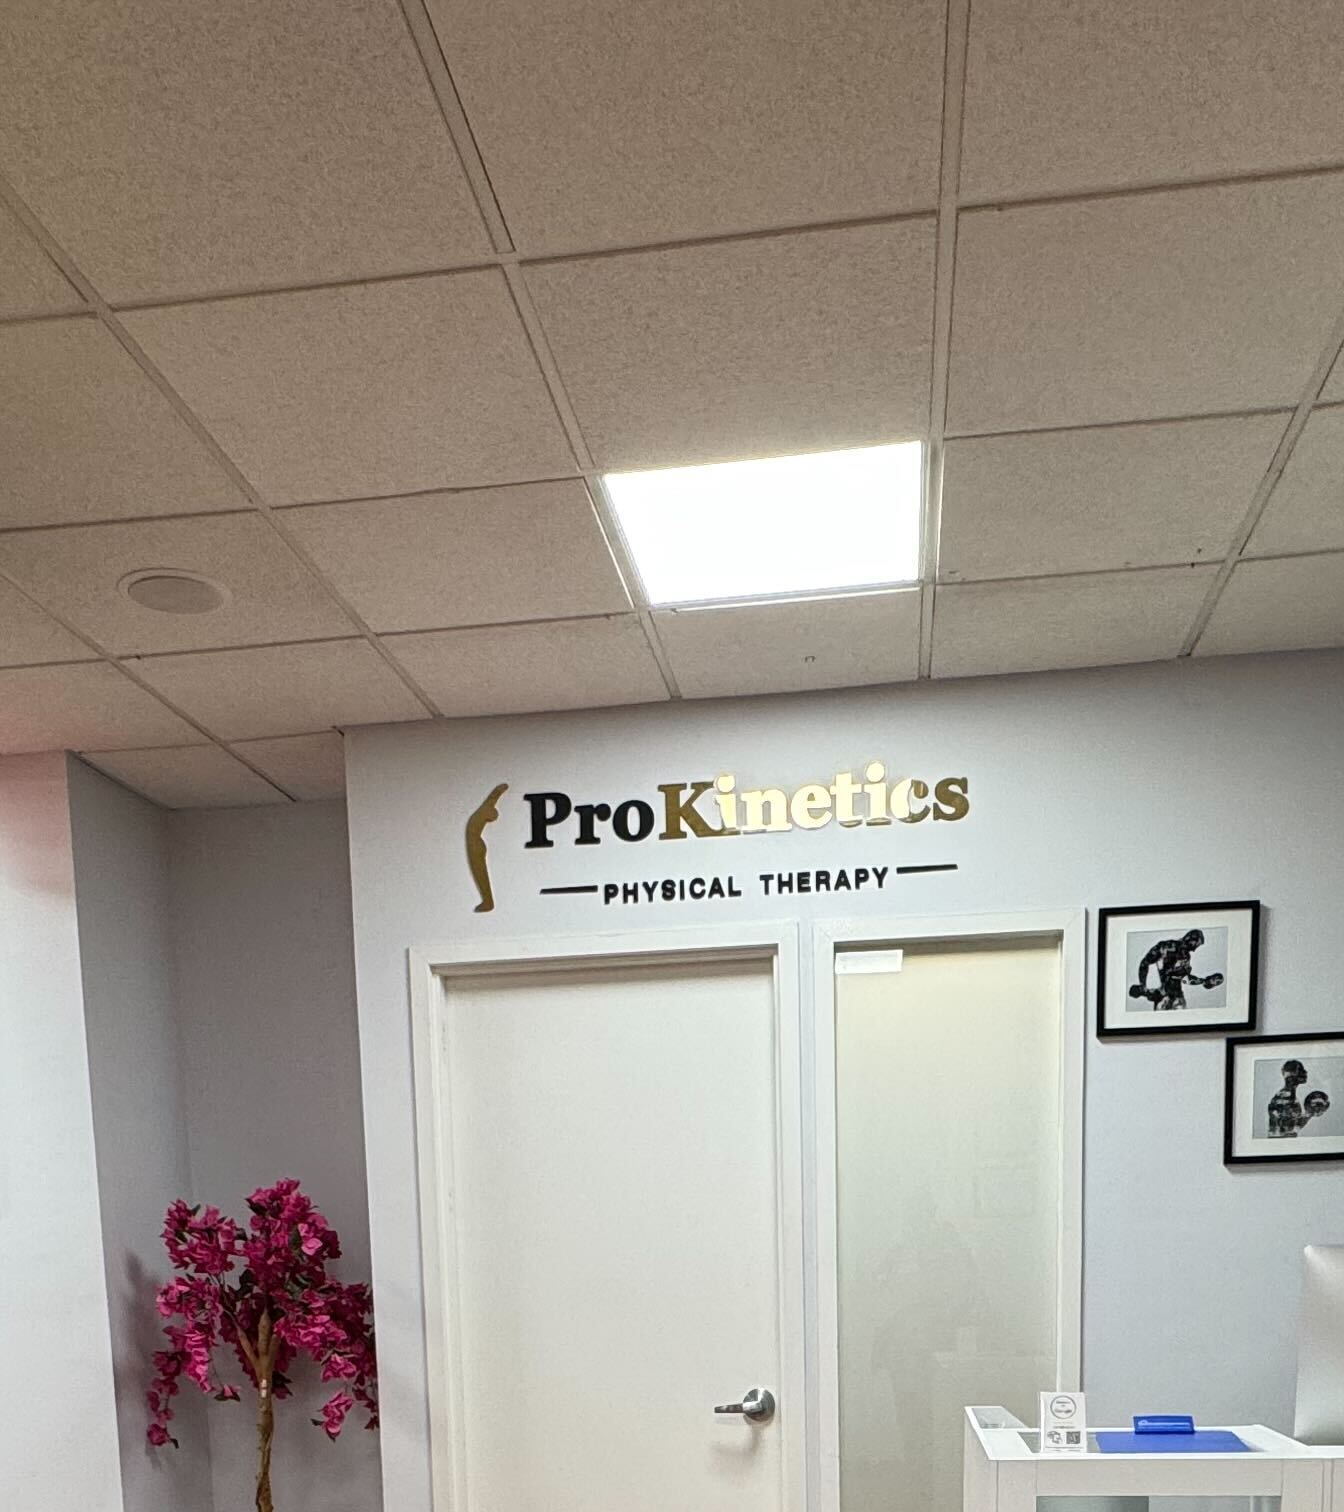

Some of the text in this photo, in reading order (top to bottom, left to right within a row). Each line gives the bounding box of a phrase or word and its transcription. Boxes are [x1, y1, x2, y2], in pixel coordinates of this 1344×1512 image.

[523, 760, 969, 849] ProKinetics
[603, 866, 889, 905] PHYSICAL THERAPY
